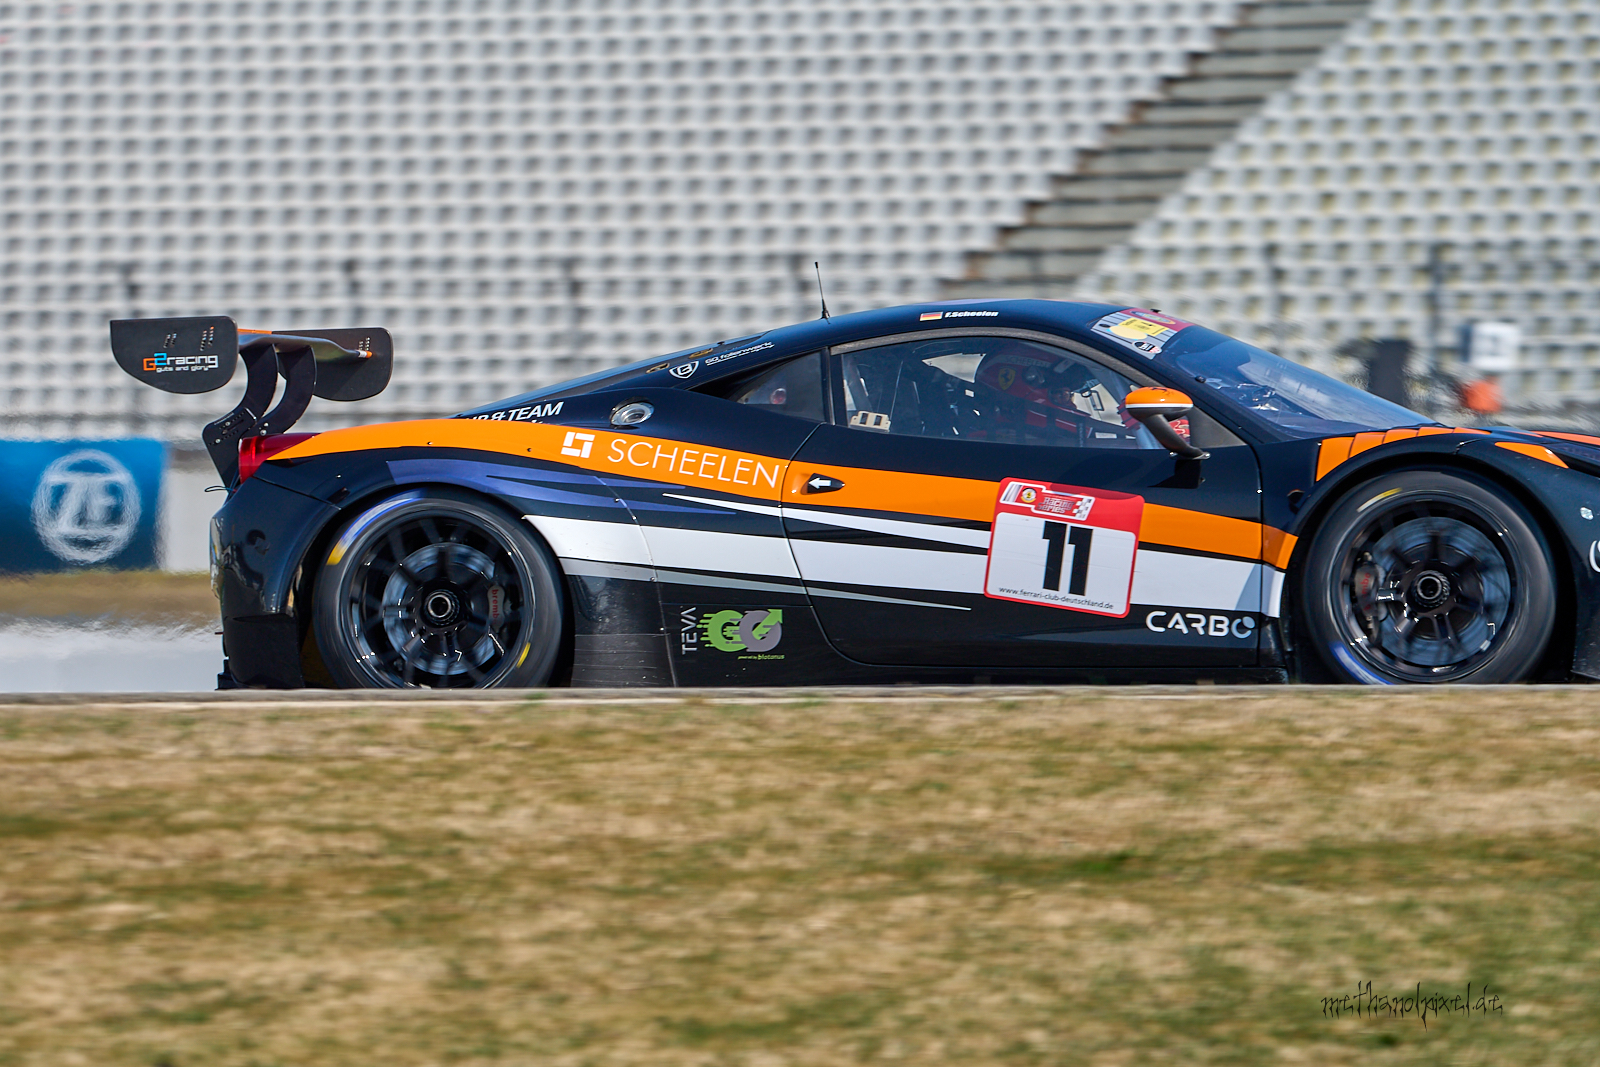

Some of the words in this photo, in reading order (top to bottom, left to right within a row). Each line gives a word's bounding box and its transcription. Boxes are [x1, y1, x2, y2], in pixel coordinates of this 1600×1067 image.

[143, 353, 219, 371] G2racing
[508, 401, 564, 421] TEAM
[607, 438, 780, 489] SCHEELEN
[1037, 503, 1066, 514] Series
[1042, 497, 1074, 511] Racing
[1042, 521, 1093, 596] 11
[999, 587, 1114, 610] www.ferrari-club-deutschland.de
[681, 607, 697, 655] TEVA
